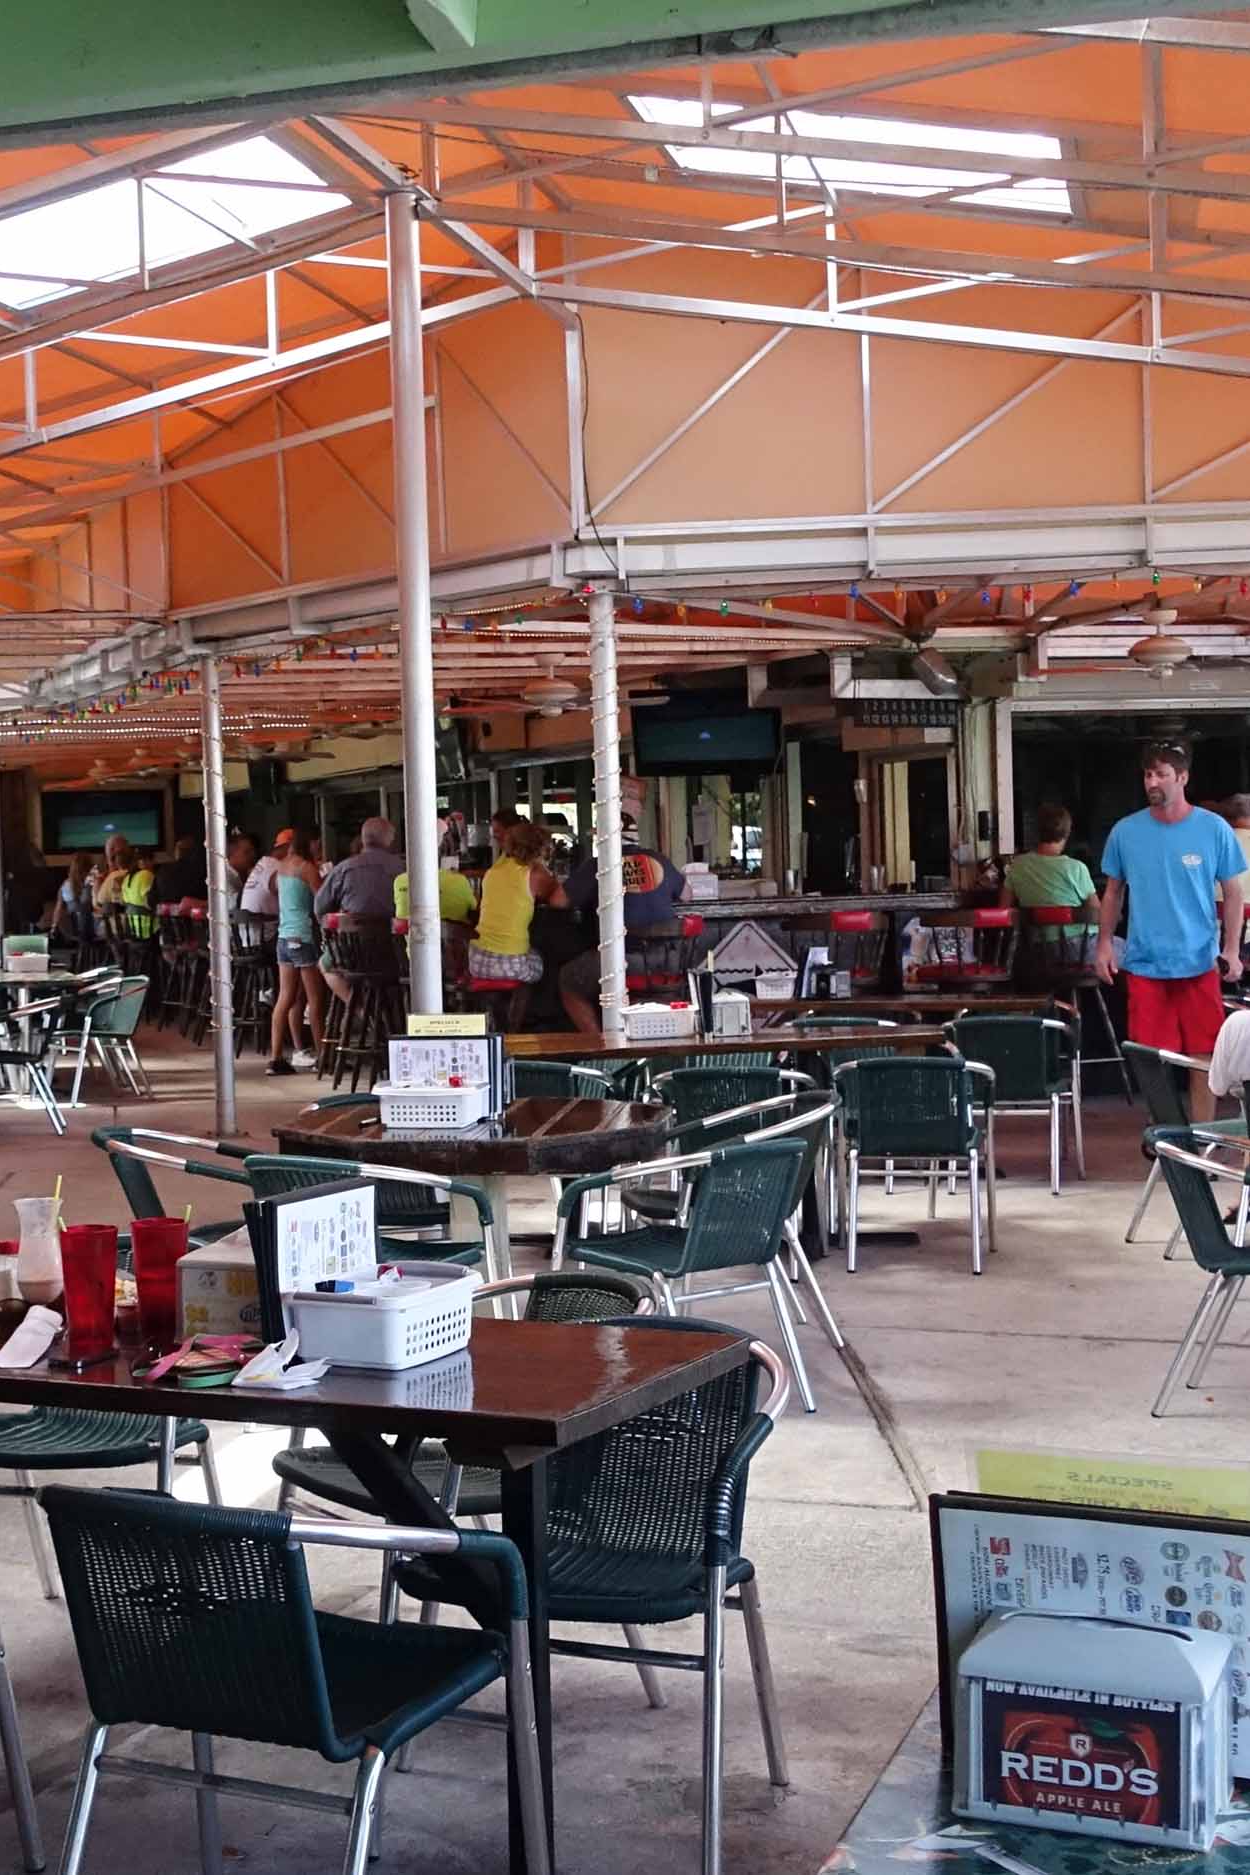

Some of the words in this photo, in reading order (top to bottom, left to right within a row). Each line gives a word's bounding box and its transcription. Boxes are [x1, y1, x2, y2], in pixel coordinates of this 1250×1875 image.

[985, 1680, 1016, 1695] NOW
[1018, 1683, 1091, 1704] AVAILABLE
[1094, 1693, 1110, 1706] IN
[1113, 1697, 1176, 1714] BOTTLES
[1076, 1738, 1088, 1751] R
[1000, 1750, 1159, 1797] REDD'S
[1035, 1792, 1086, 1809] APPLE
[1092, 1799, 1122, 1814] ALE
